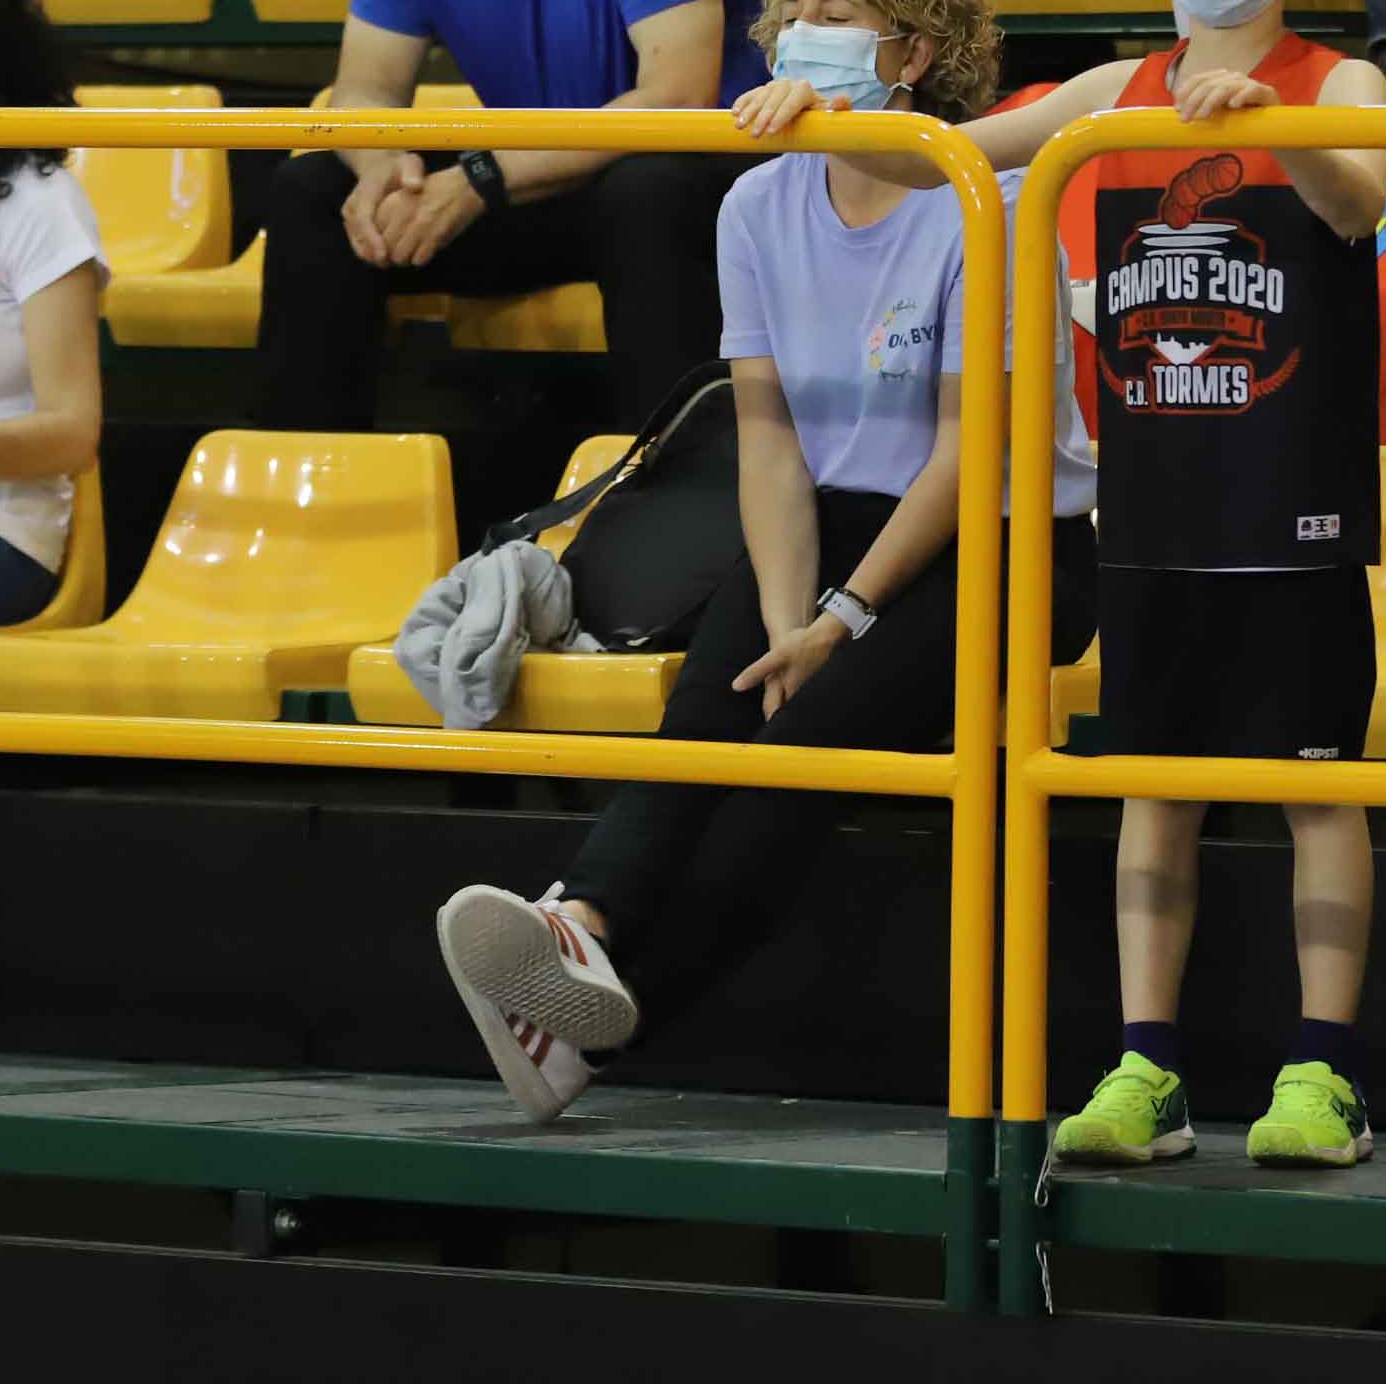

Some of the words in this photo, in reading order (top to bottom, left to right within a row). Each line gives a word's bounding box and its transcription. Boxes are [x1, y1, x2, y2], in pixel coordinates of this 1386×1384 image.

[1108, 257, 1200, 315] CAMPUS
[1208, 259, 1285, 314] 2020
[1153, 366, 1249, 405] TORMES
